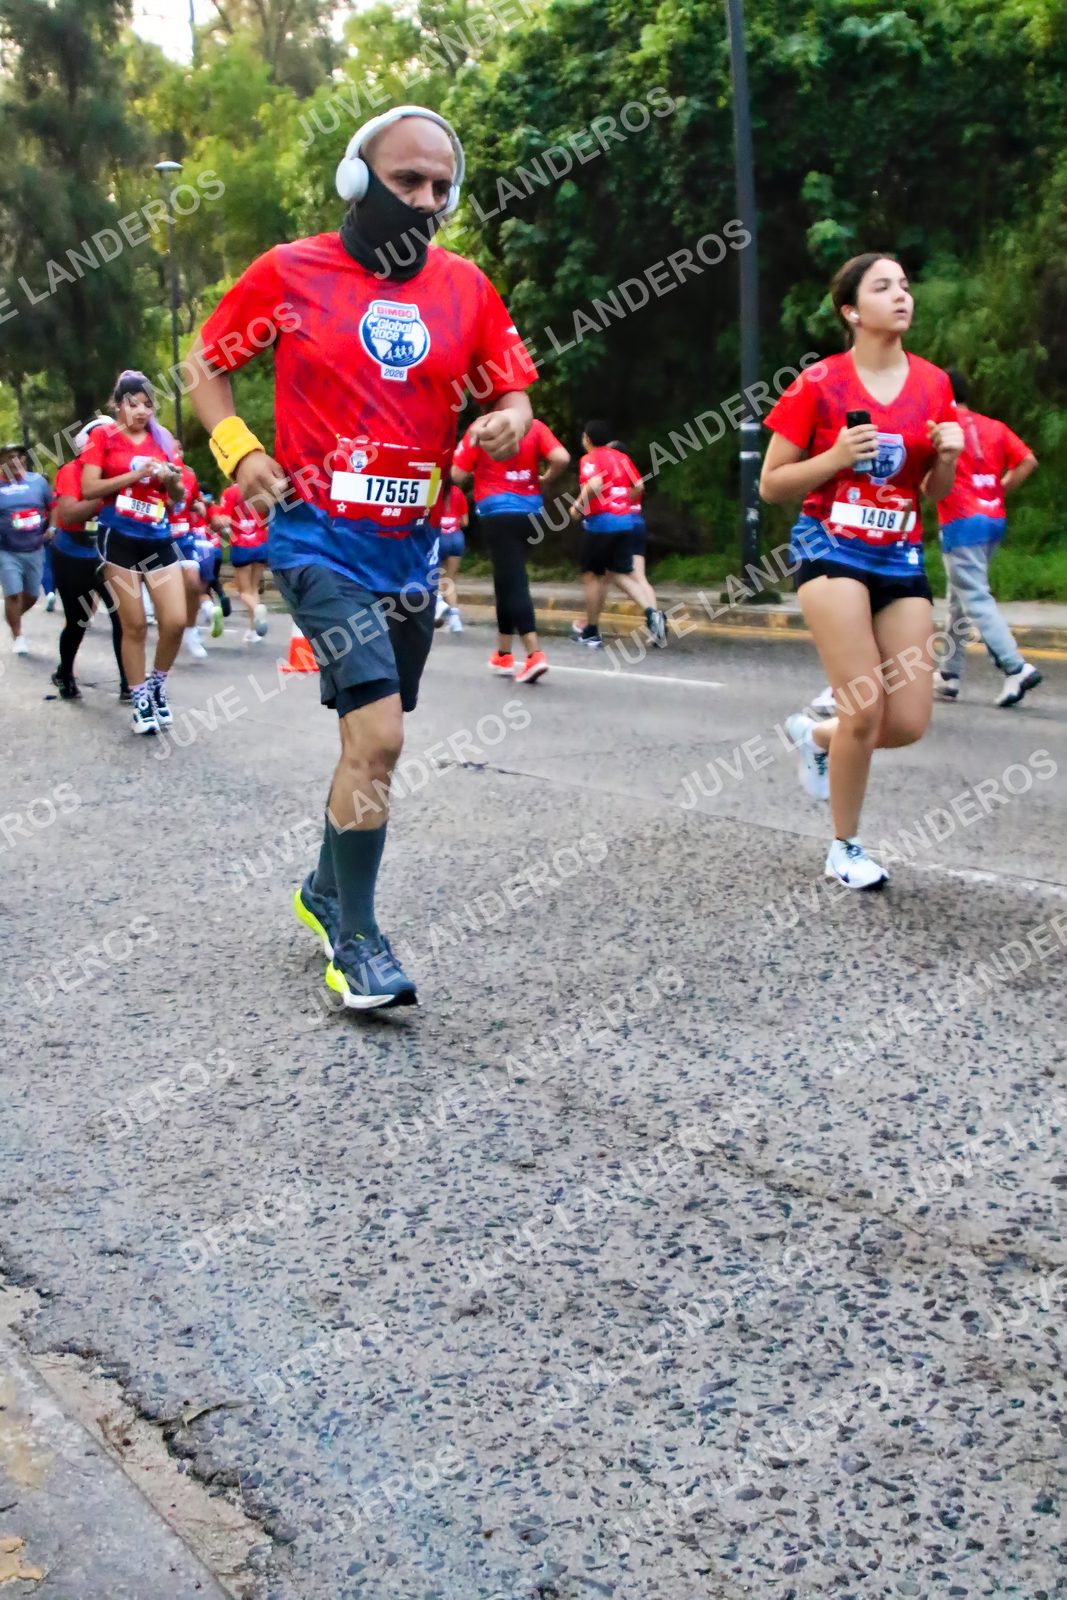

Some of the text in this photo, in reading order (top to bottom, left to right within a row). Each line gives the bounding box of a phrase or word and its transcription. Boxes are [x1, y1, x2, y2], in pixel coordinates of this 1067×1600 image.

[376, 306, 413, 319] BIMBO
[370, 326, 400, 341] Race
[377, 318, 413, 334] Global
[366, 477, 420, 504] 17555
[861, 508, 896, 529] 1408
